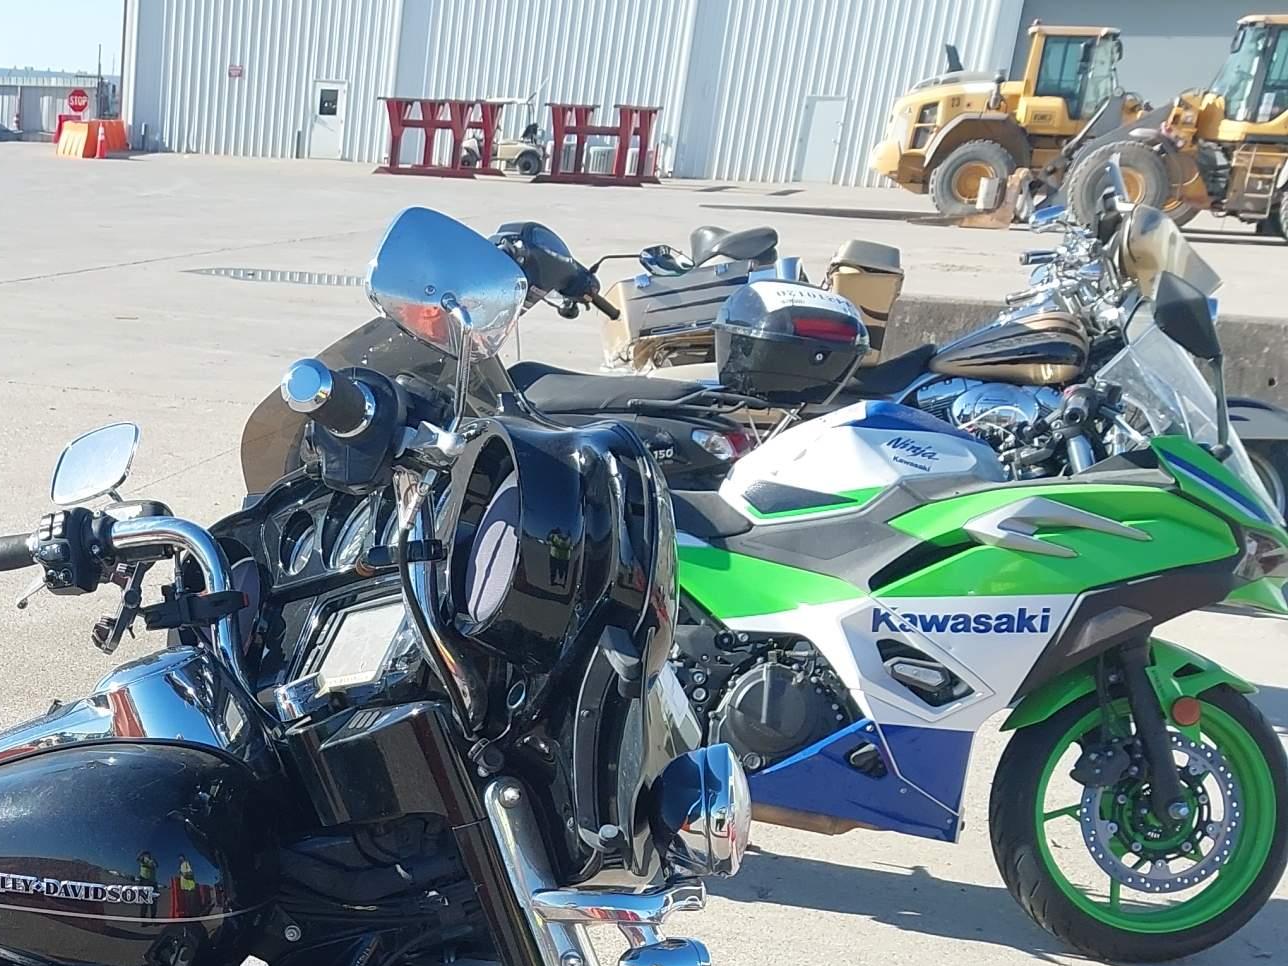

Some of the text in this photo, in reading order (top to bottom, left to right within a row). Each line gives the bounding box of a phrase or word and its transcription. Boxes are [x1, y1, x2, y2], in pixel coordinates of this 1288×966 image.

[69, 95, 88, 106] STOP
[653, 446, 674, 460] 150
[886, 437, 940, 460] Ninja
[893, 456, 931, 472] Kawasaki
[872, 607, 1051, 633] Kawasaki
